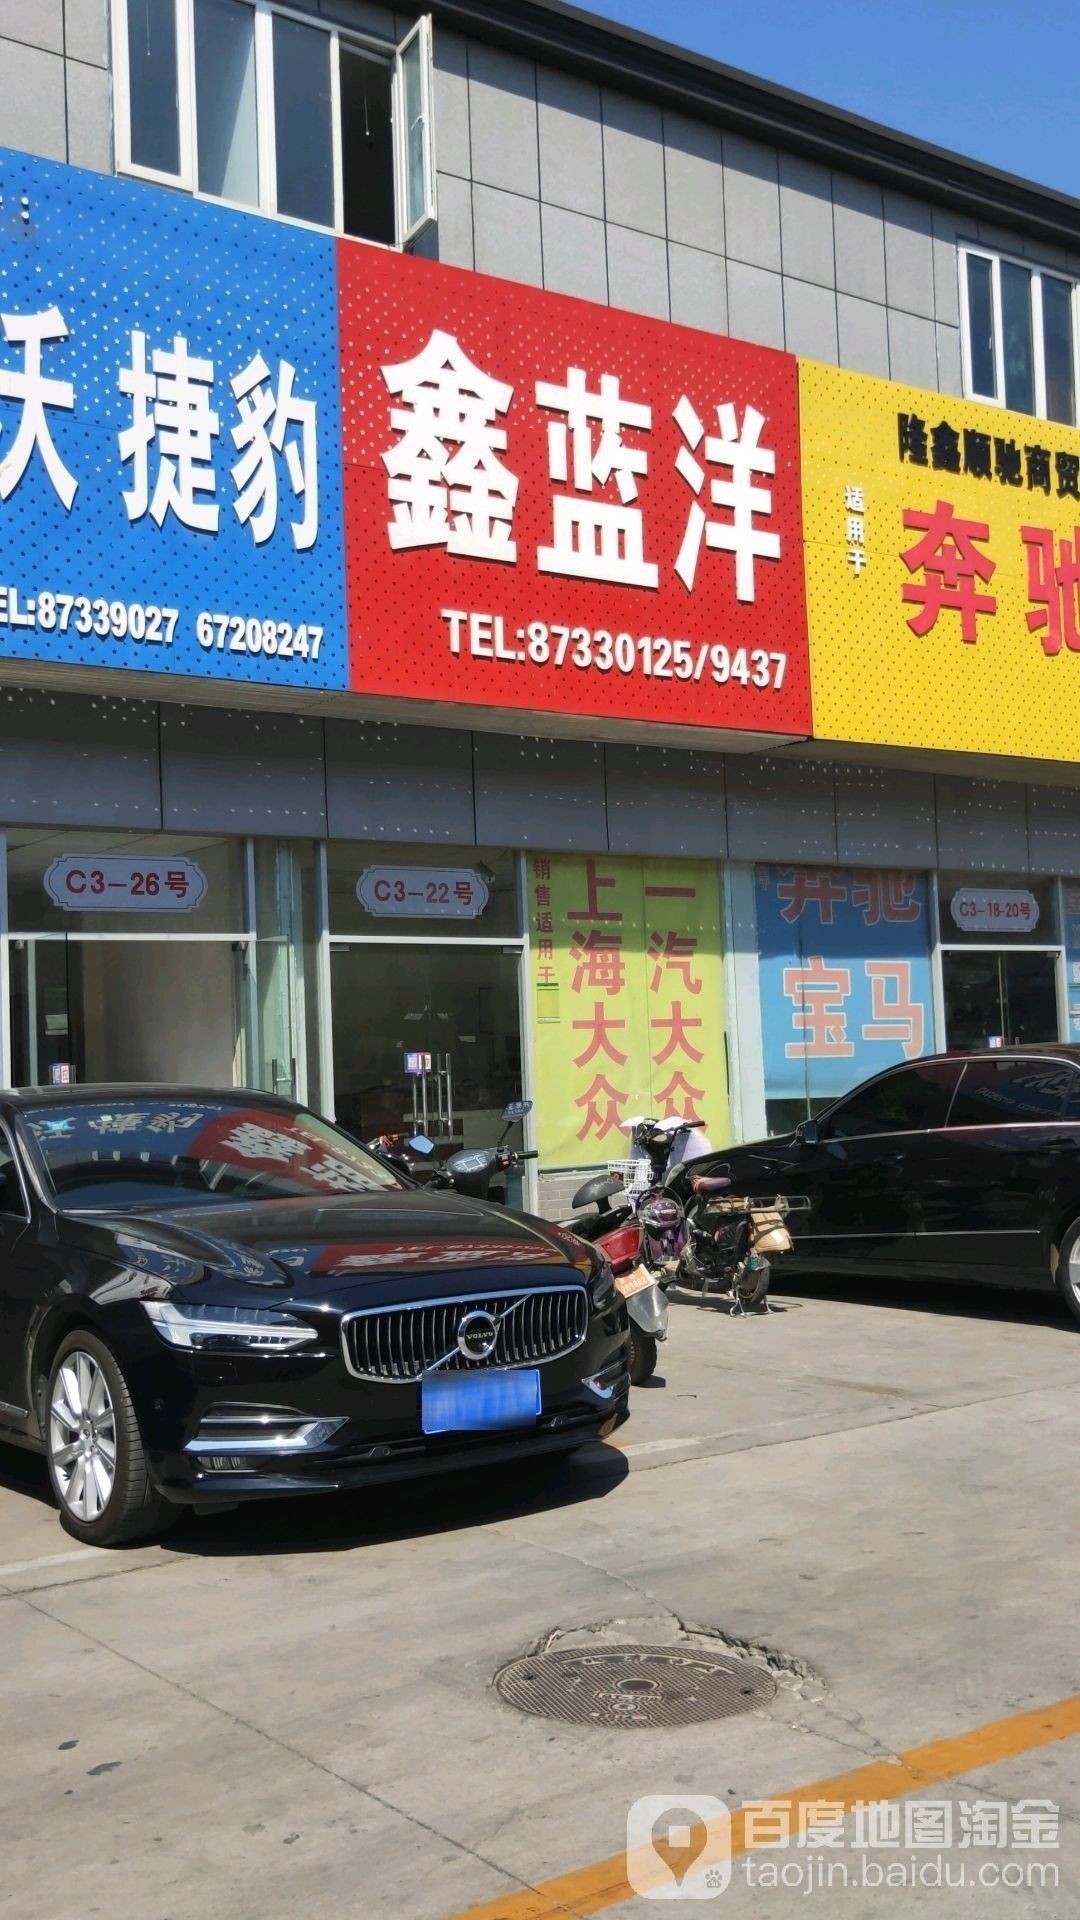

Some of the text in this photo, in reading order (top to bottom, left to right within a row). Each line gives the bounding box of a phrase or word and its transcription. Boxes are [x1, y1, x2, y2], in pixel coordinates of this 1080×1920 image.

[118, 330, 319, 551] 捷豹
[380, 329, 781, 602] 鑫蓝洋
[196, 612, 324, 659] 67208247
[441, 608, 787, 689] TEL:87330125/9437
[567, 858, 632, 1142] 上海大众
[645, 886, 709, 1134] 一汽大众
[783, 955, 925, 1059] 宝马
[465, 1331, 494, 1340] VOLVO
